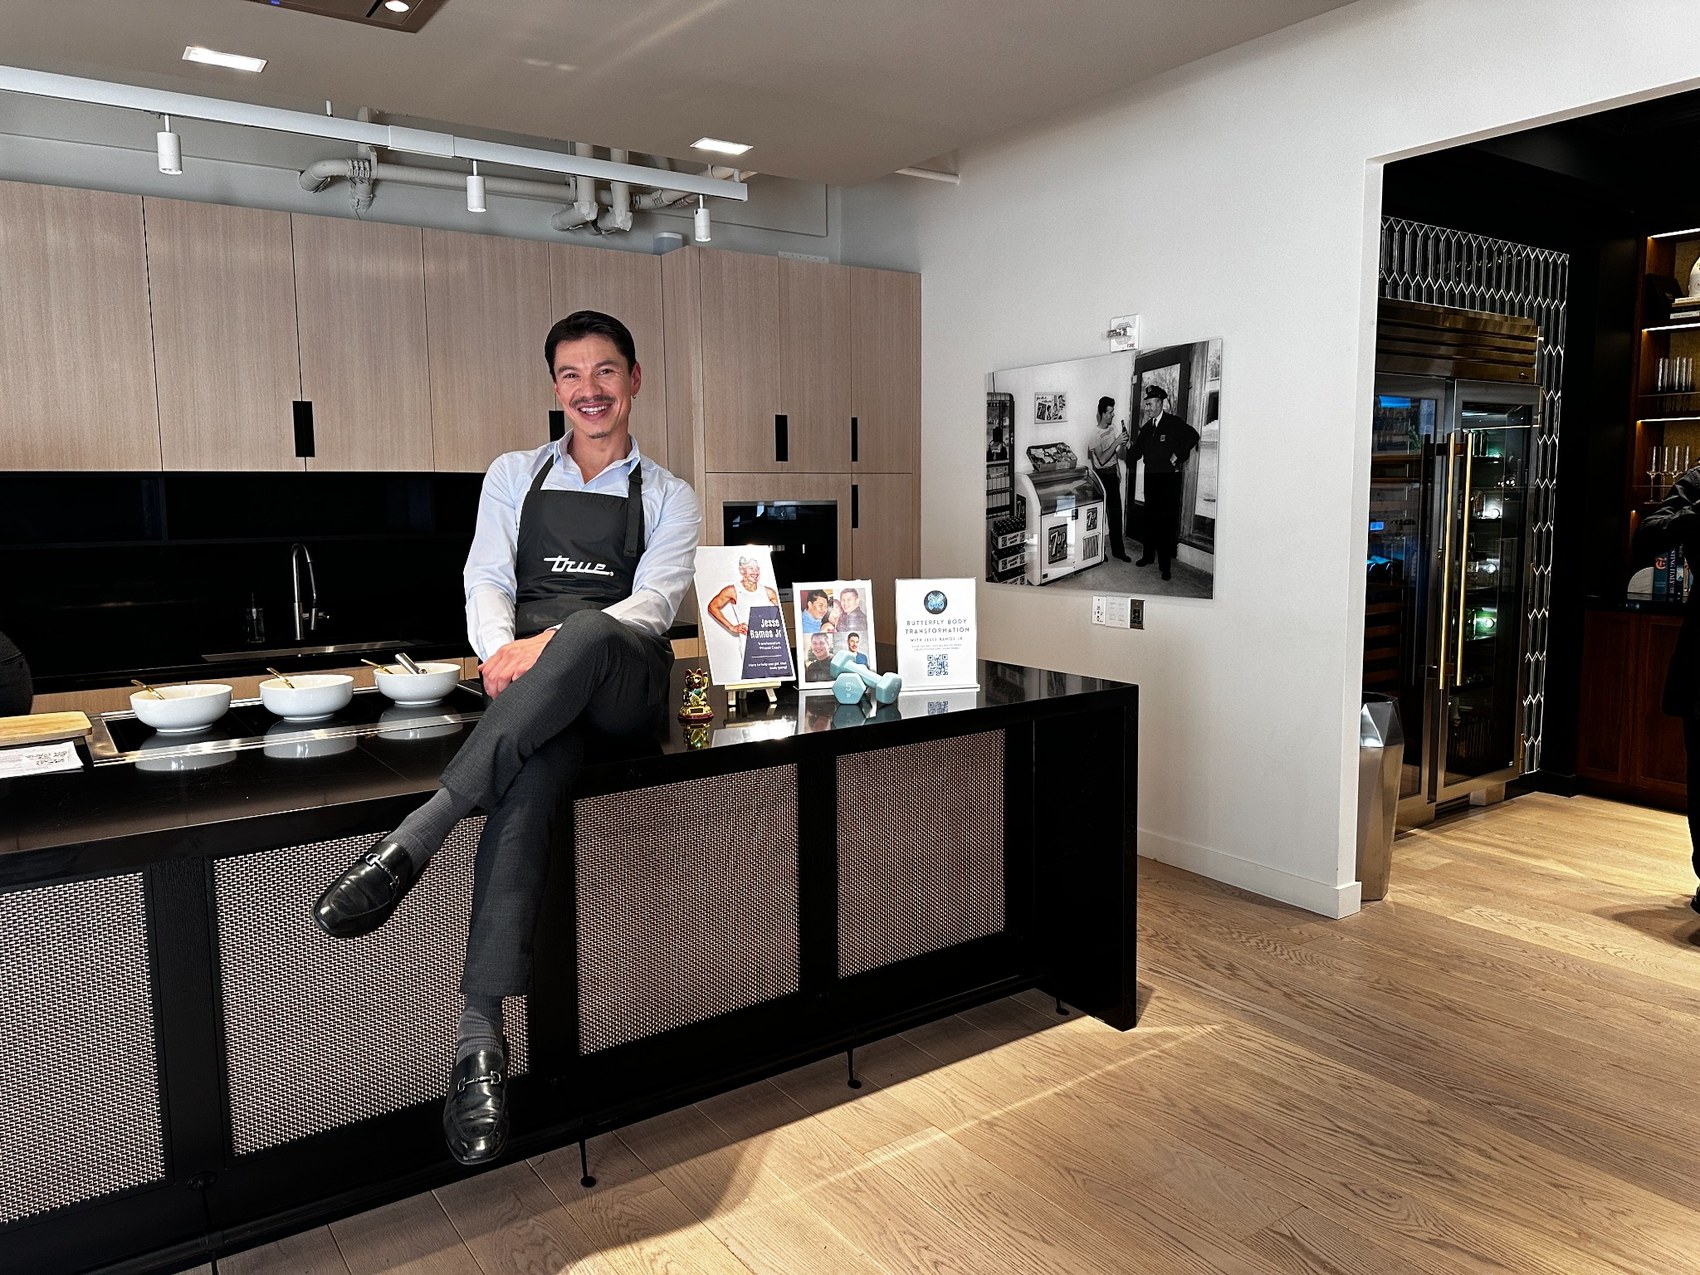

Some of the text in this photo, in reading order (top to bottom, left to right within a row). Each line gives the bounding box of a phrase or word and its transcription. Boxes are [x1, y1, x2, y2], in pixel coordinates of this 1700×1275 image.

[761, 619, 780, 628] Jesse
[750, 629, 781, 639] Ramos Jr
[904, 626, 970, 635] TRANSFORMATION
